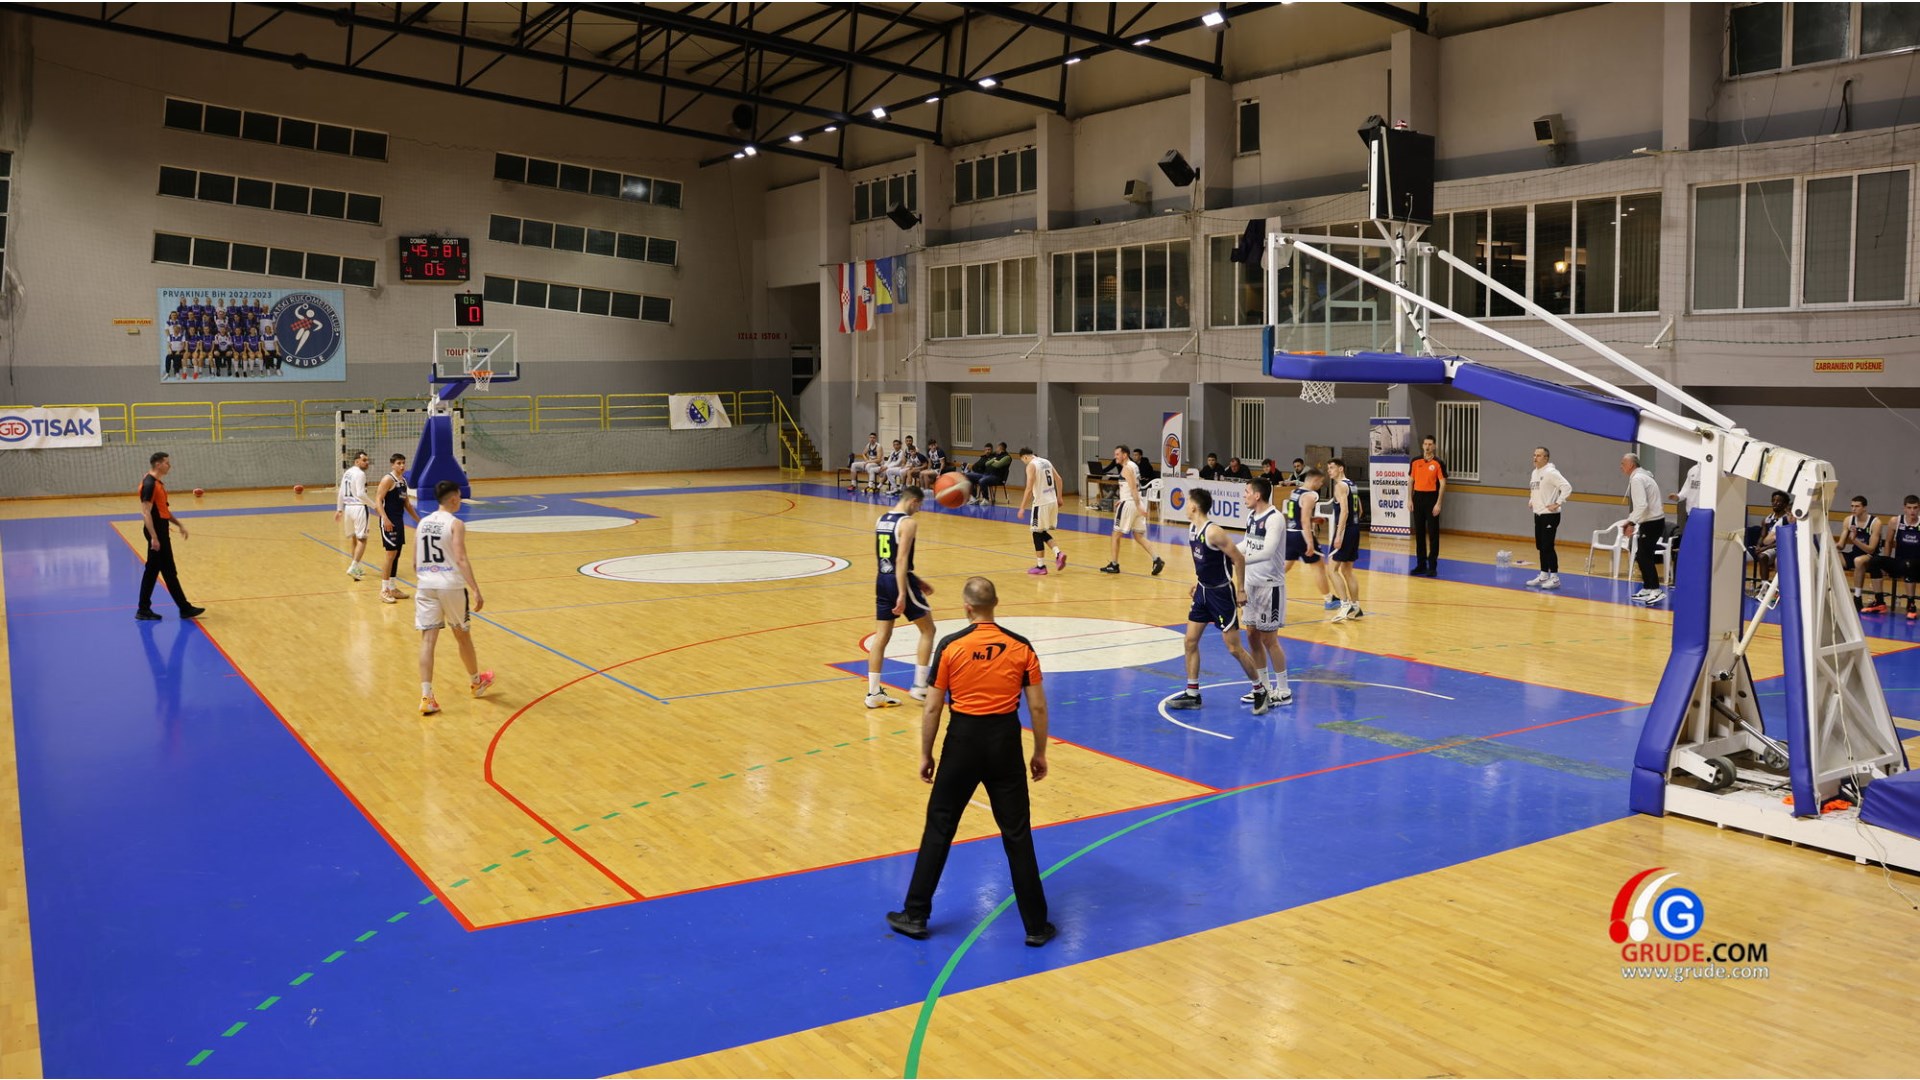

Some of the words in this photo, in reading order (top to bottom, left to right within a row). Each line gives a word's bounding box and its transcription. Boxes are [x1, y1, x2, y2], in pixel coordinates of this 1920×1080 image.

[411, 245, 429, 257] 45
[442, 245, 460, 258] 81
[163, 290, 209, 298] PRVAKINJE
[228, 291, 272, 299] 2022/2023
[469, 306, 480, 322] 0
[285, 355, 326, 367] GRUDE
[32, 418, 95, 437] TISAK
[1045, 469, 1053, 487] 6
[1226, 490, 1240, 498] KLUB
[1382, 488, 1400, 496] KLUBA
[1378, 500, 1404, 509] GRUDE
[422, 535, 445, 564] 15
[1260, 612, 1267, 624] 9
